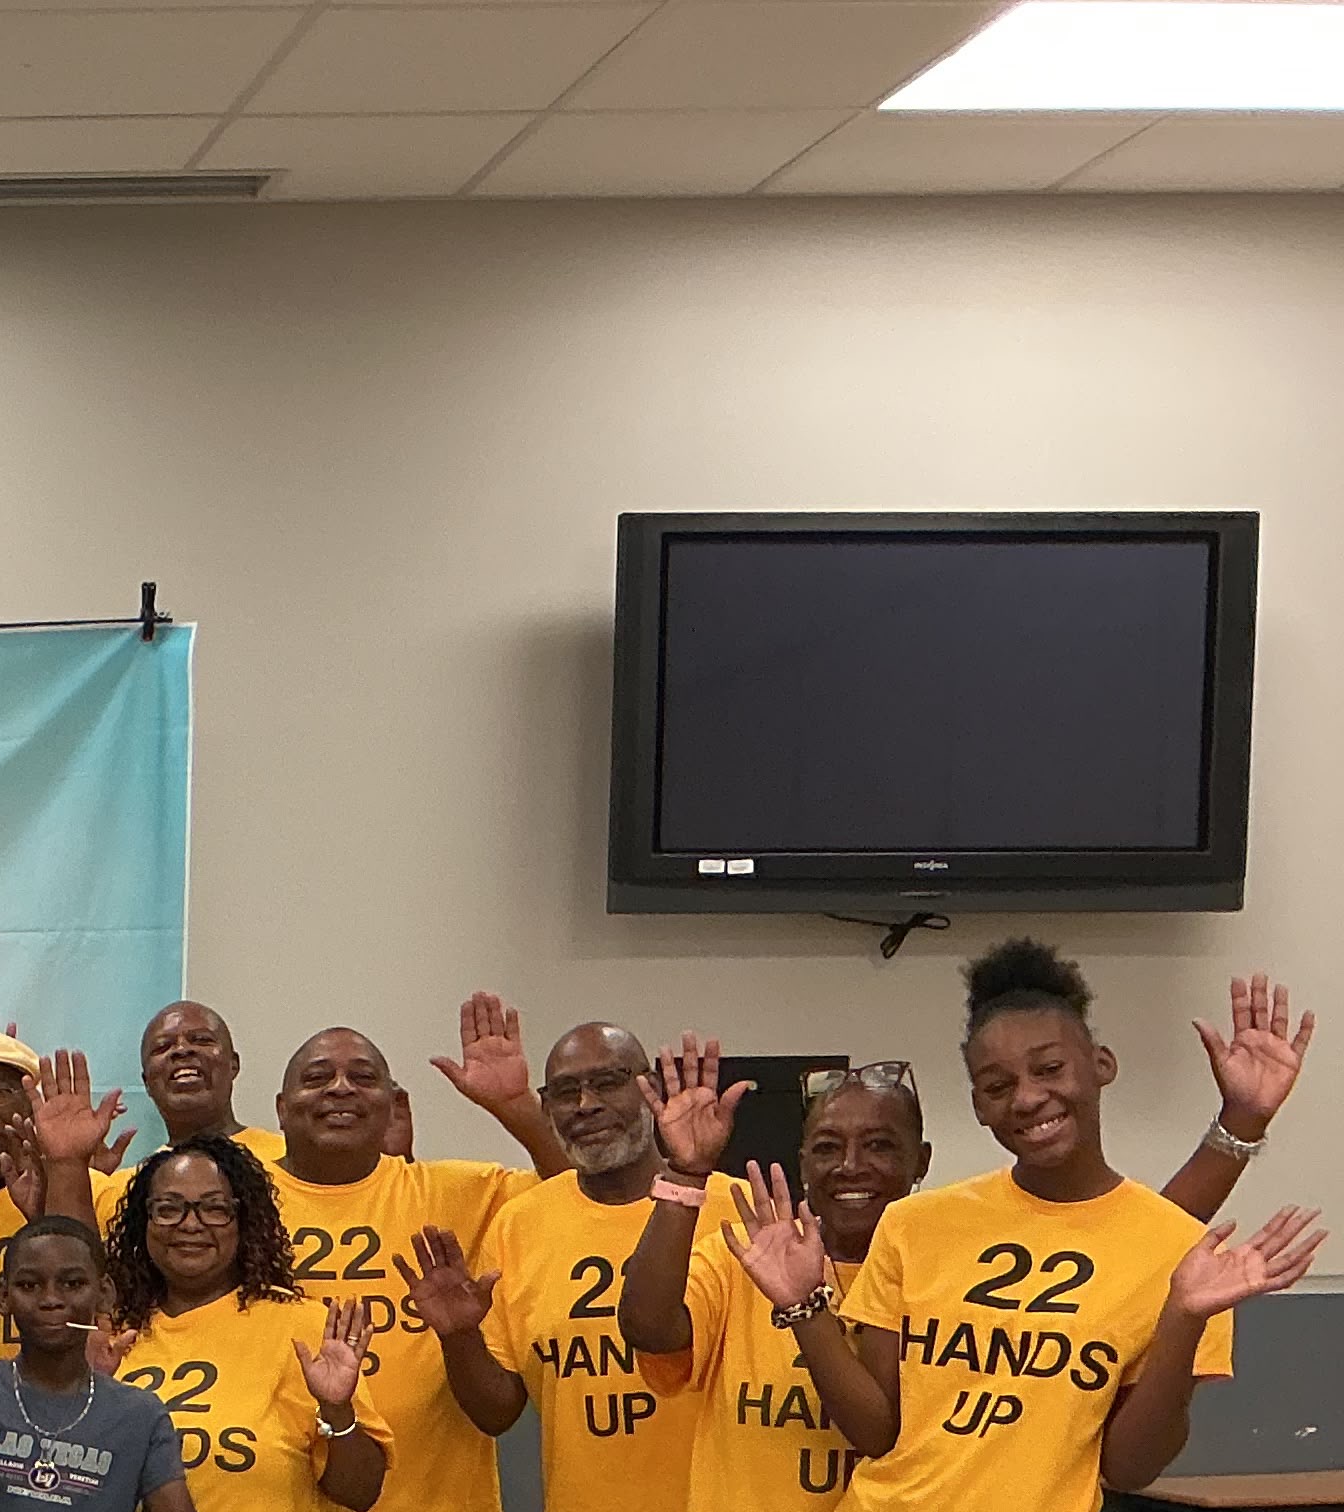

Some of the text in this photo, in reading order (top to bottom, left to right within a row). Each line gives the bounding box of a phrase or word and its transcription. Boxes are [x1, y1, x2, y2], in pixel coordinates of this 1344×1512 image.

[292, 1226, 386, 1280] 22
[963, 1243, 1095, 1314] 22
[569, 1256, 628, 1320] 2
[531, 1334, 635, 1380] HAN
[899, 1315, 1119, 1391] HANDS
[585, 1392, 657, 1437] UP
[942, 1391, 1023, 1438] UP
